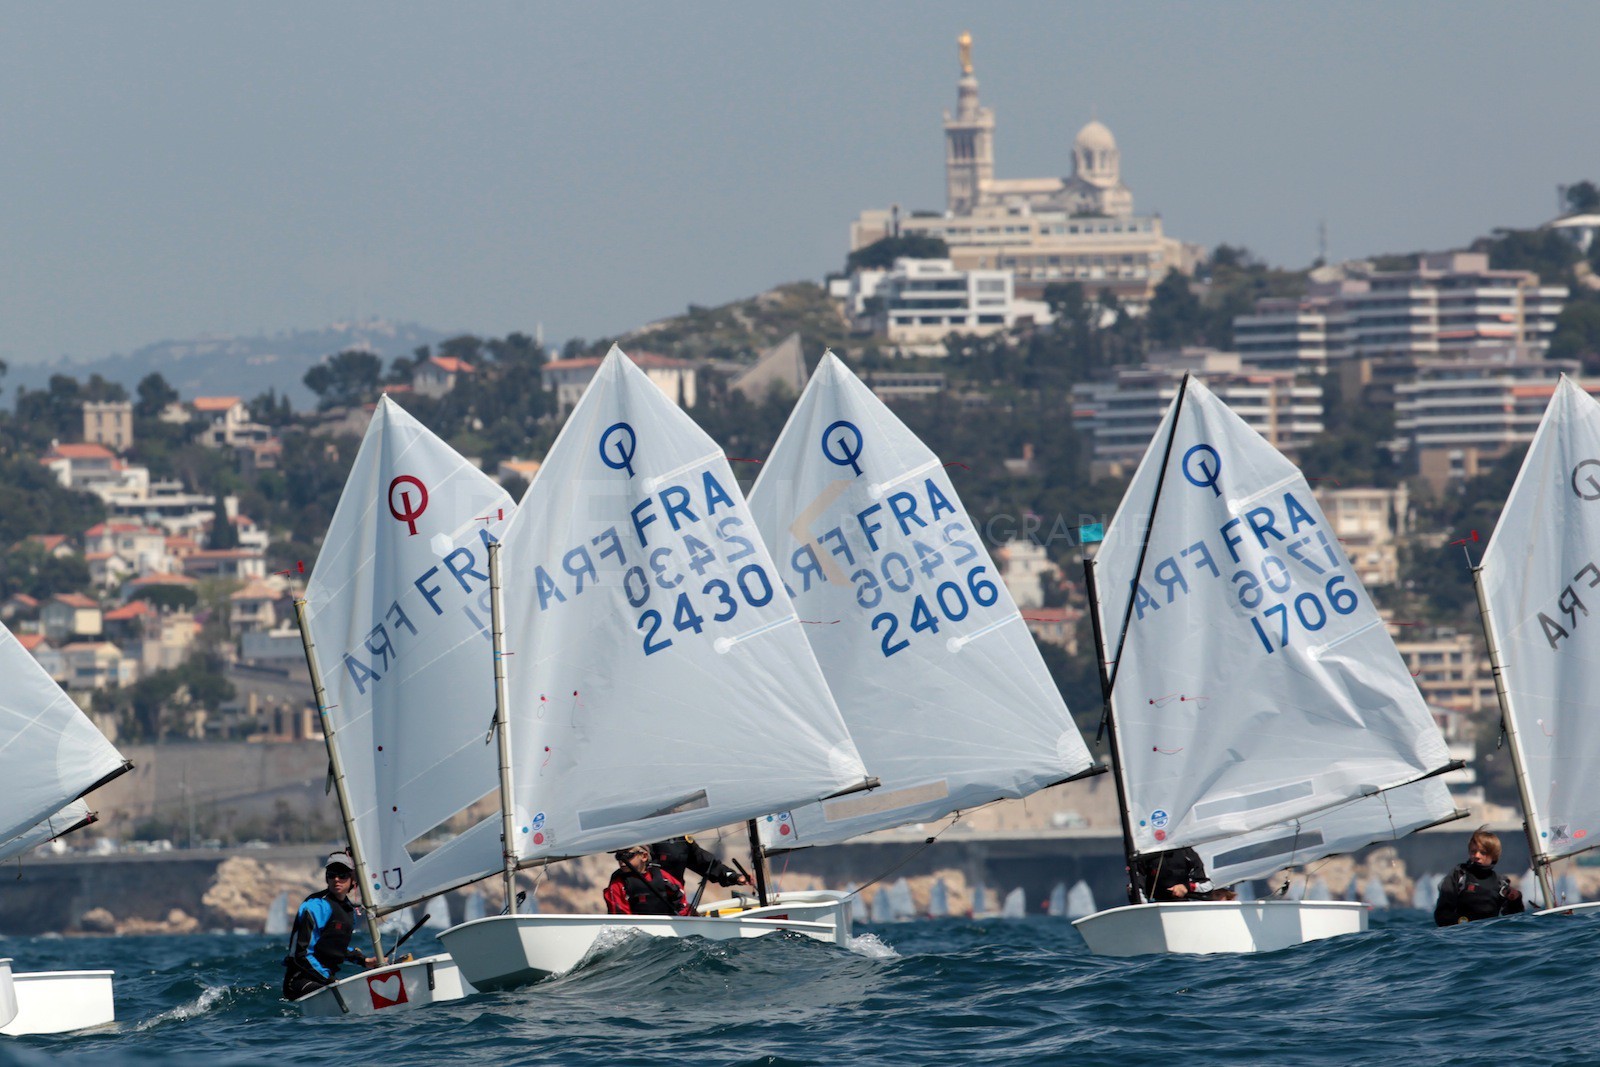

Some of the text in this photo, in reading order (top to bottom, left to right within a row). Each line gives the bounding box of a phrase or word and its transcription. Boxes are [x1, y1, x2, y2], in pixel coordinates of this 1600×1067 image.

[630, 470, 735, 548] FRA
[857, 478, 956, 552] FRA
[1220, 492, 1317, 564] FRA
[637, 564, 773, 656] 2430
[871, 566, 998, 657] 2406
[1251, 576, 1358, 654] 1706
